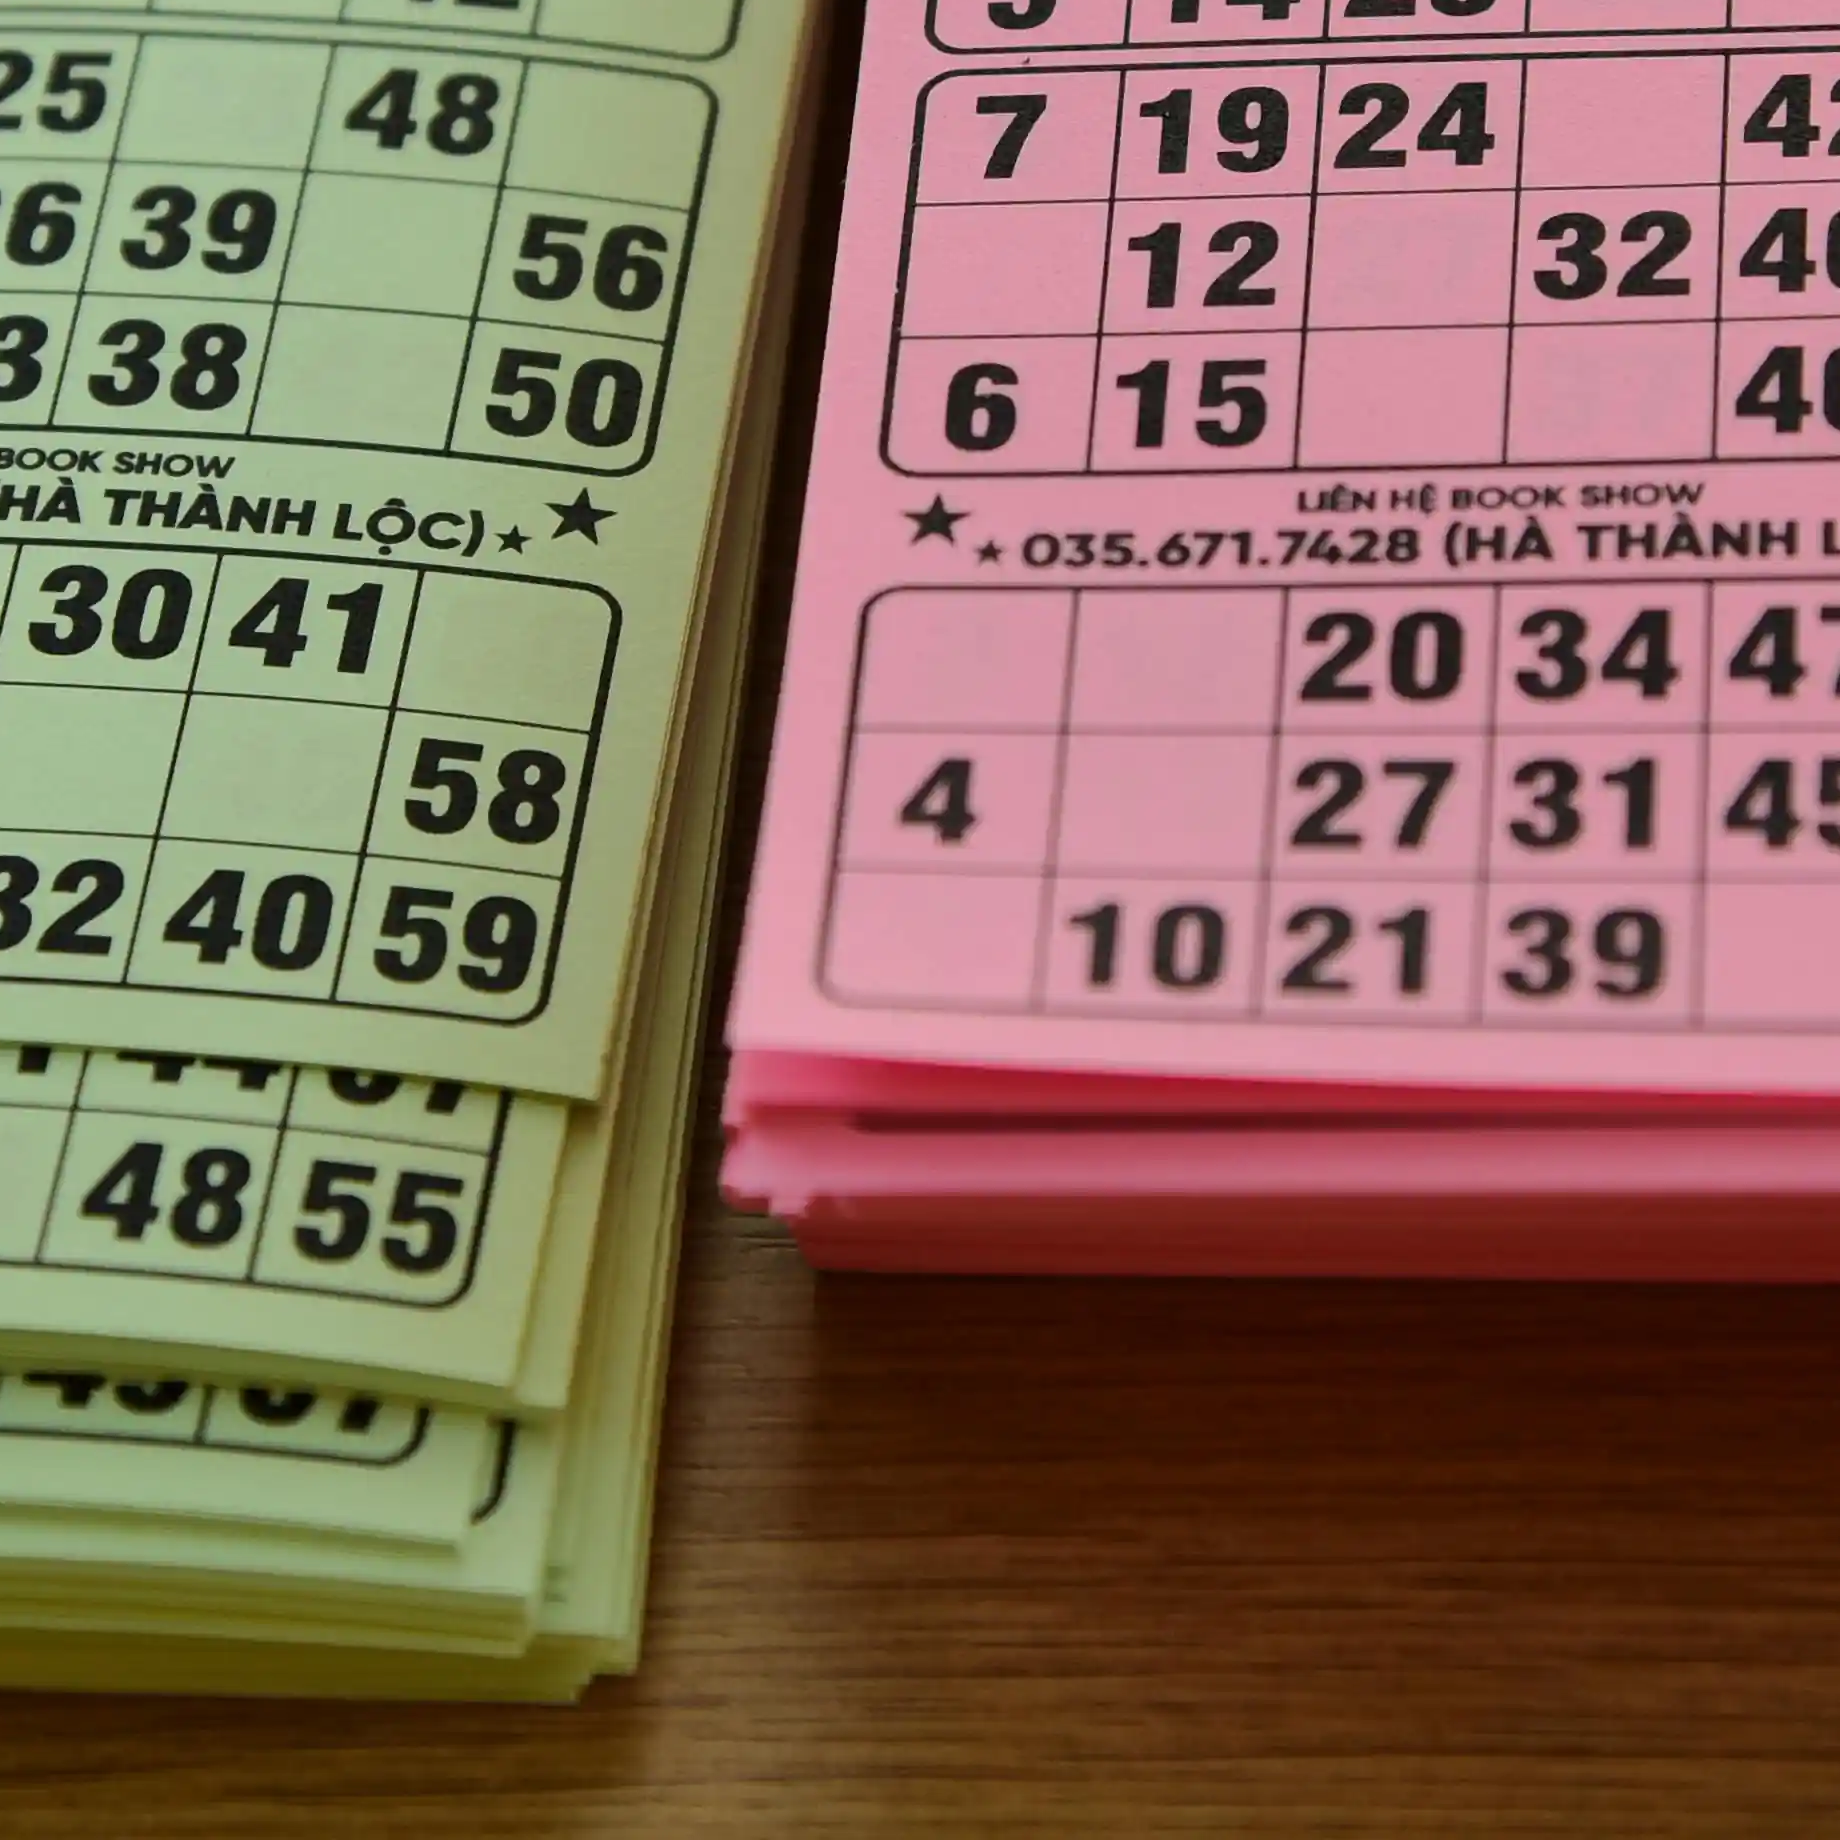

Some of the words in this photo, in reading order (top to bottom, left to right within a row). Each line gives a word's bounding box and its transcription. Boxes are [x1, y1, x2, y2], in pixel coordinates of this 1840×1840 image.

[343, 67, 501, 158] 48
[974, 92, 1049, 181] 7
[1138, 85, 1291, 176] 19
[1332, 80, 1497, 171] 24
[119, 184, 278, 276] 39
[511, 212, 670, 313] 56
[86, 317, 249, 412] 38
[484, 346, 645, 449] 50
[943, 361, 1020, 453] 6
[1114, 357, 1269, 450] 15
[112, 451, 236, 479] SHOW
[1297, 483, 1377, 514] LIÊN
[1389, 482, 1437, 516] HỆ
[1450, 485, 1565, 511] BOOK
[1579, 482, 1705, 508] SHOW
[103, 482, 317, 537] THÀNH
[332, 497, 485, 558] LỘC)
[1021, 527, 1421, 569] 035.671.7428
[1443, 514, 1554, 569] (HÀ
[1576, 510, 1799, 561] THÀNH
[403, 736, 567, 846] 58
[898, 756, 978, 845] 4
[1288, 758, 1457, 850] 27
[1507, 756, 1657, 852] 31
[161, 868, 335, 973] 40
[372, 884, 539, 995] 59
[79, 1141, 253, 1250] 48
[293, 1158, 466, 1276] 55
